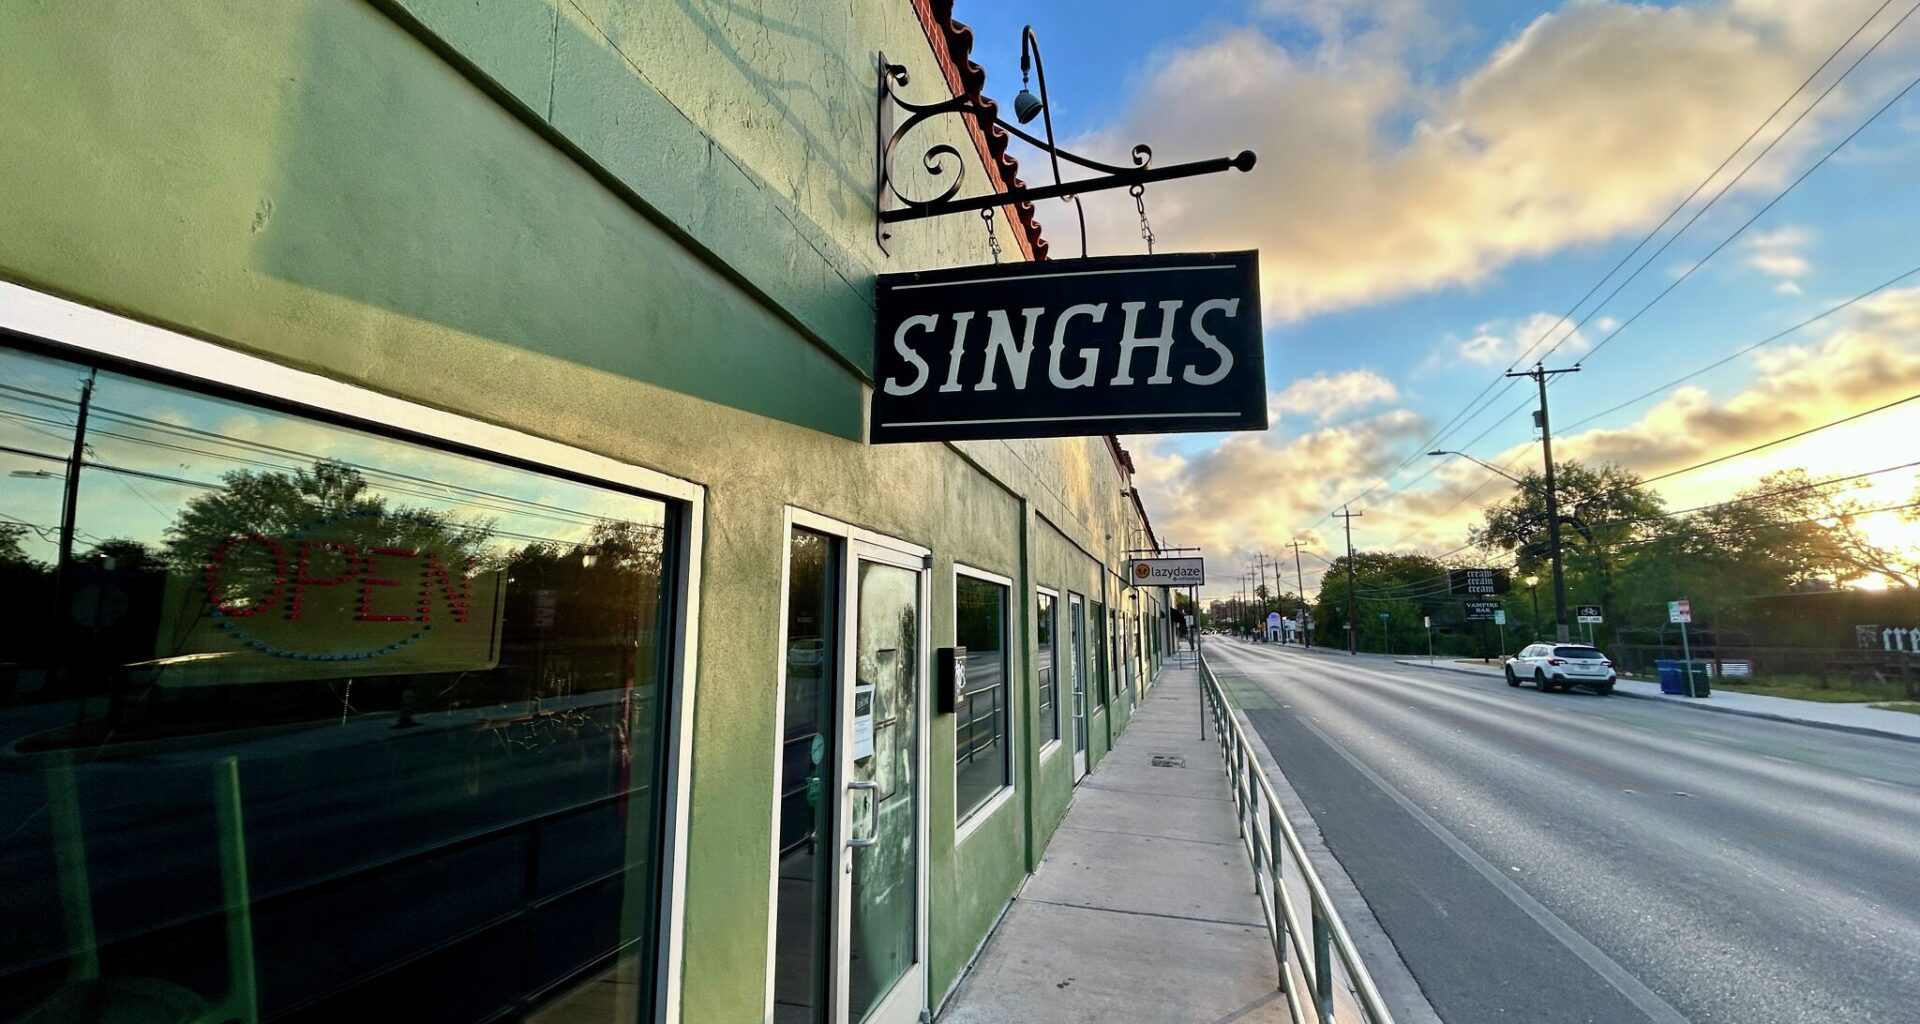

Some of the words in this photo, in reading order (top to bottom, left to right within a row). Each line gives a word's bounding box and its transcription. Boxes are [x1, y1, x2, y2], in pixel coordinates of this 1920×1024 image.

[883, 298, 1240, 396] SINGHS
[205, 532, 475, 623] OPEN
[1151, 566, 1200, 579] lazydaze
[1466, 570, 1492, 578] cream
[1468, 585, 1494, 593] cream
